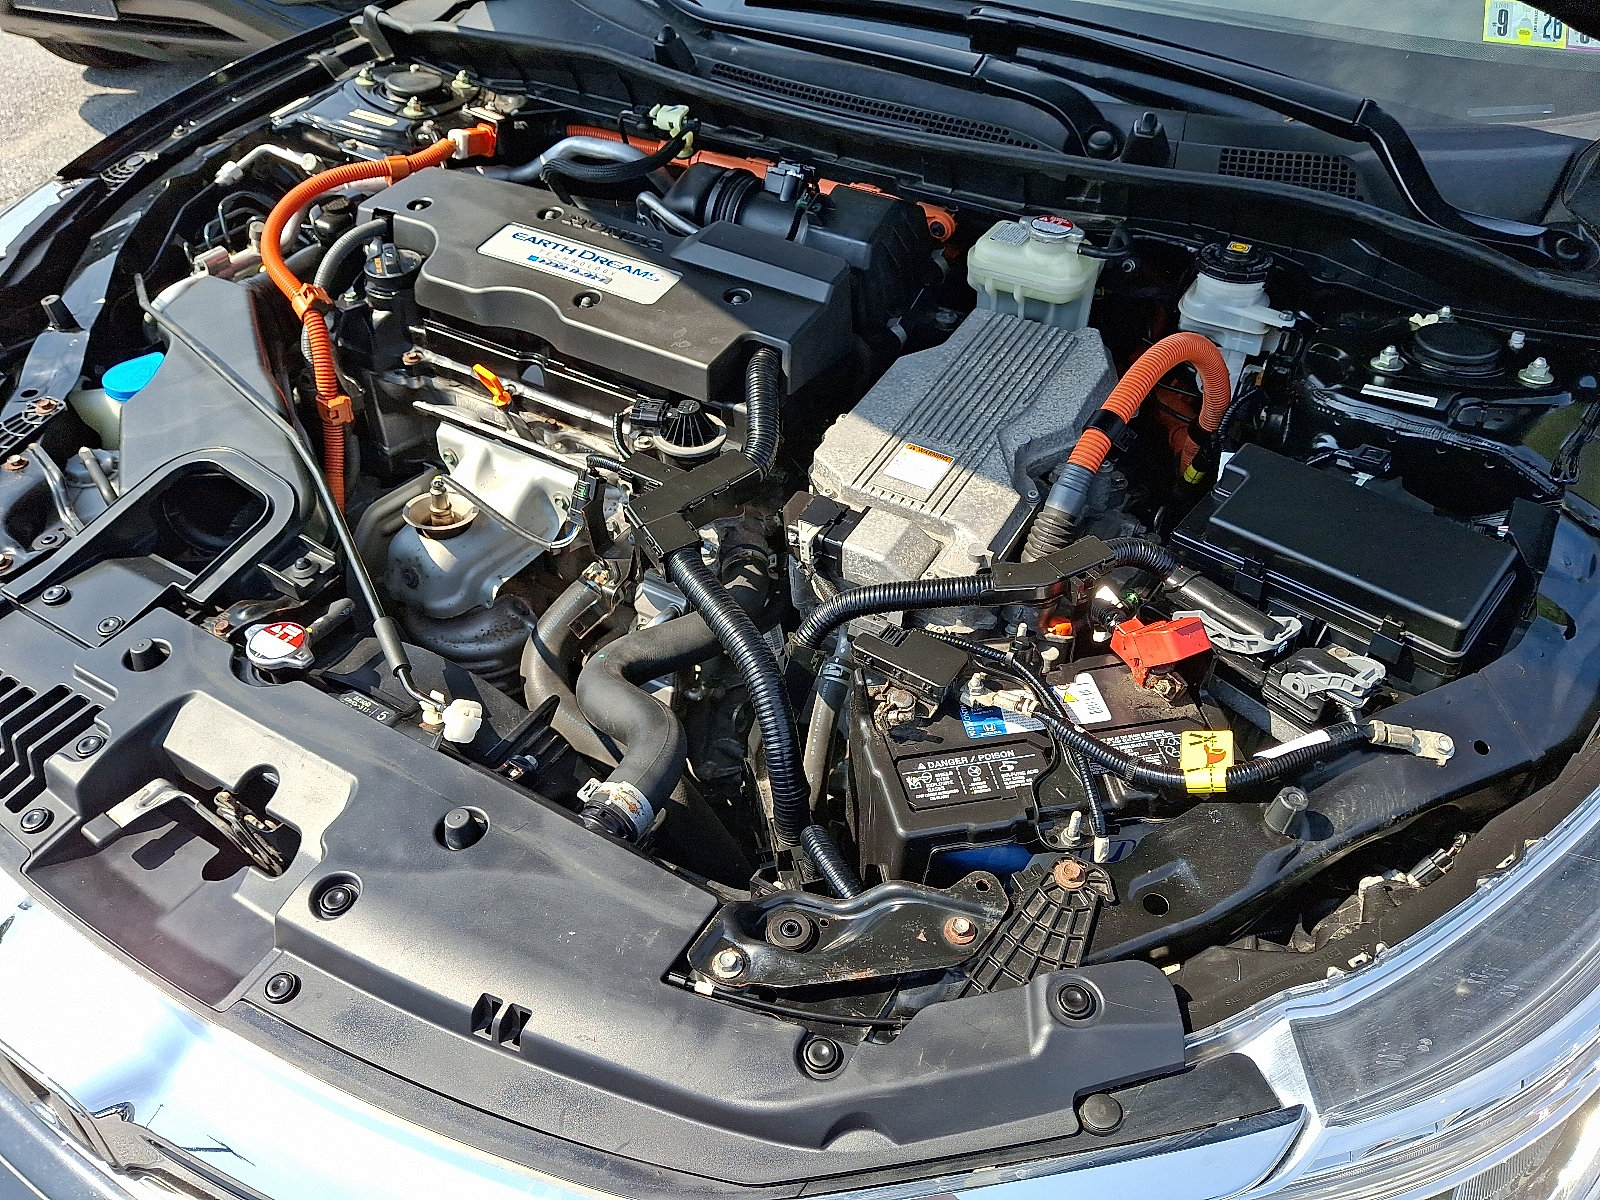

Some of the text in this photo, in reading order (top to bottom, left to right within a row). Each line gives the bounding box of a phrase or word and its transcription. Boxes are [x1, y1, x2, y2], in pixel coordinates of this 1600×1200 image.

[1497, 9, 1508, 36] 9
[512, 232, 575, 255] EARTH
[577, 250, 664, 282] DREAMS
[539, 249, 617, 276] TECHNOLOGY
[927, 756, 968, 768] DANGER
[977, 750, 1015, 762] POISON
